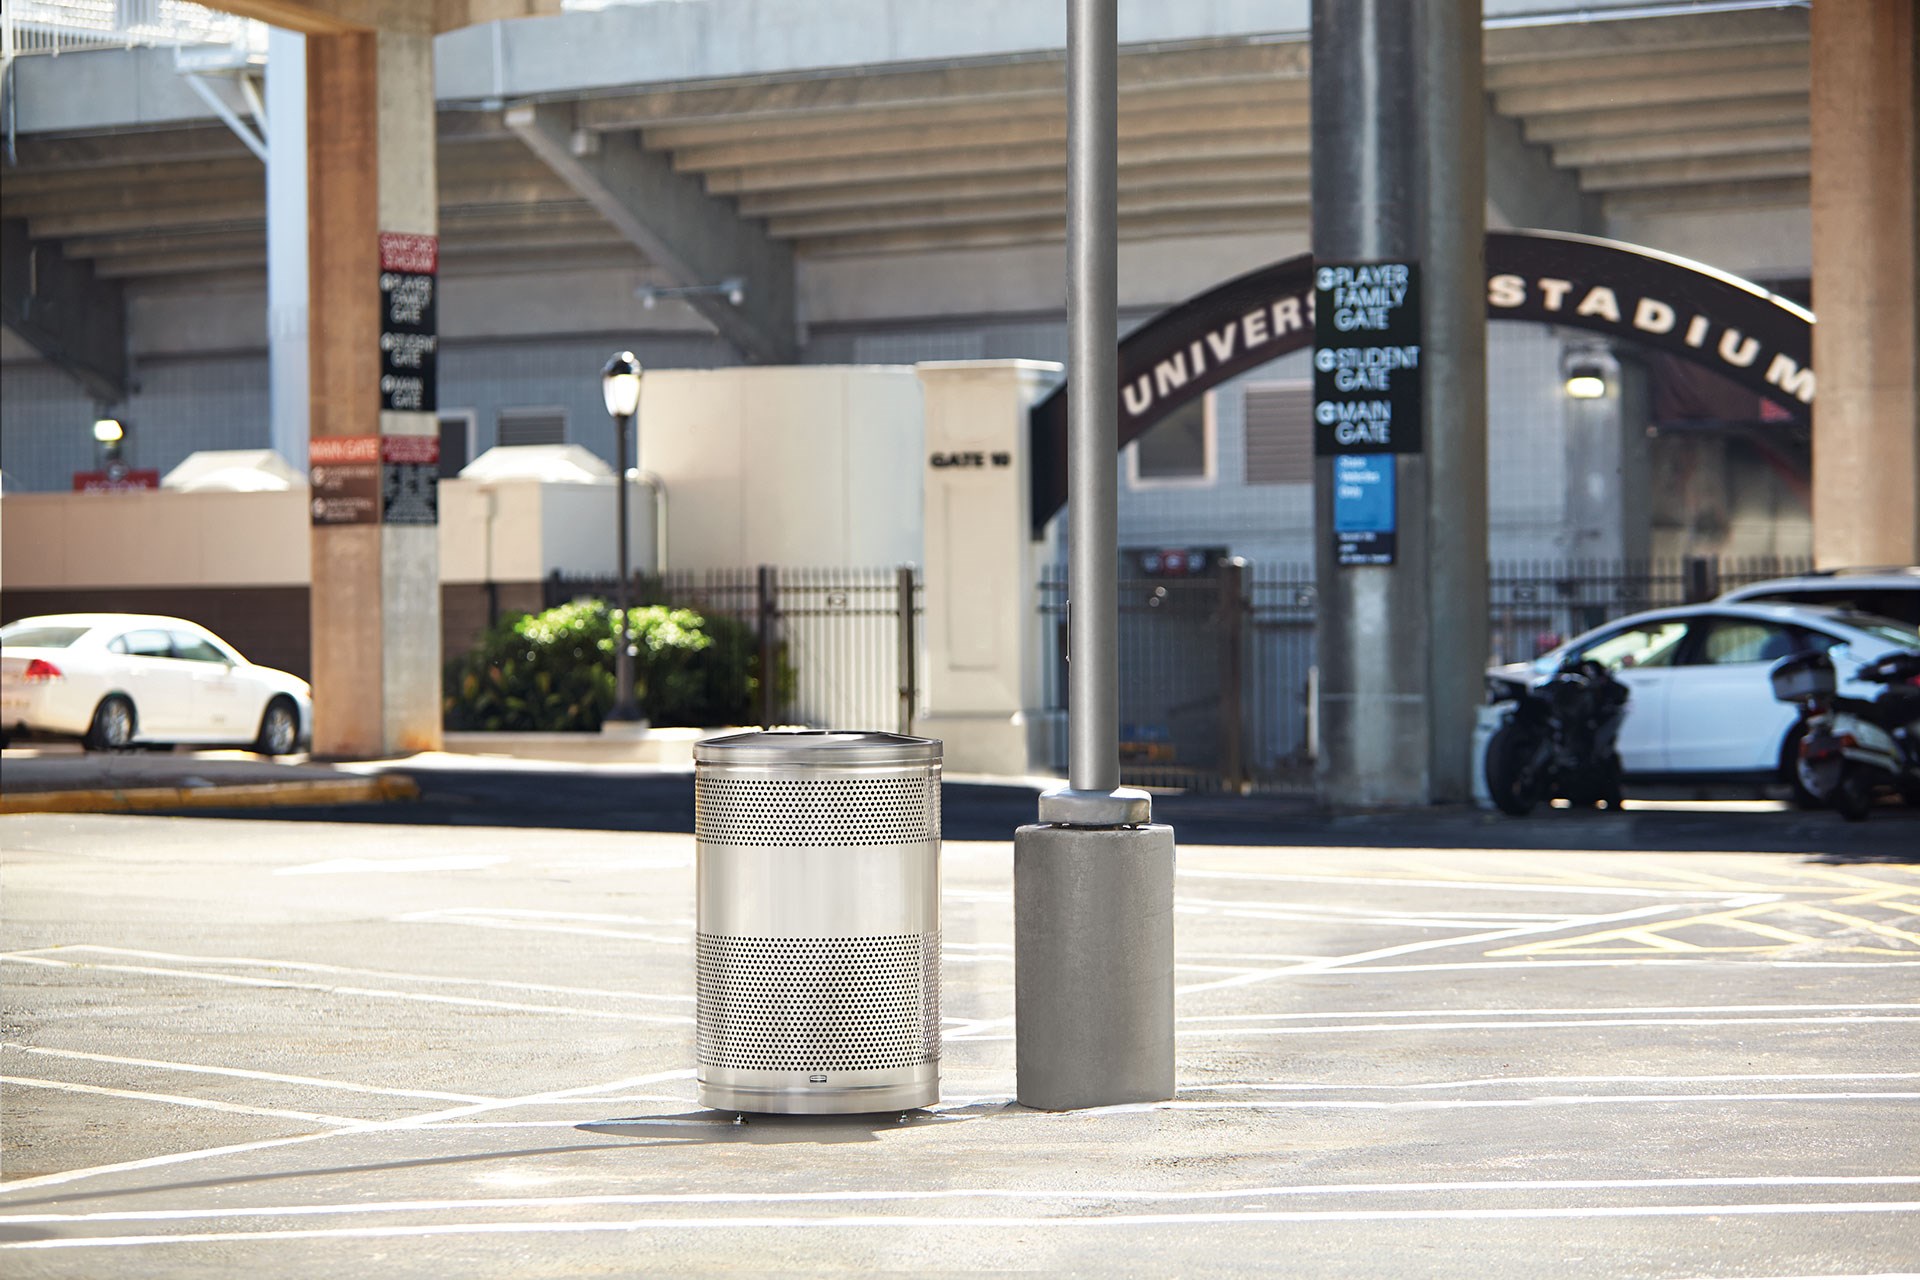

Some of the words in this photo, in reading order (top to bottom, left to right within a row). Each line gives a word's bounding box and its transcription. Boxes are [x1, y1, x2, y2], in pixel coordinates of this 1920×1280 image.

[1333, 265, 1408, 287] PLAYER
[1334, 286, 1407, 309] FAMILY
[1333, 308, 1389, 331] GATE
[1487, 273, 1816, 403] STADIUM
[1335, 346, 1420, 369] STUDENT
[1335, 368, 1390, 392] GATE
[1335, 400, 1391, 422] MAIN
[1335, 420, 1390, 444] GATE
[930, 451, 983, 468] GATE
